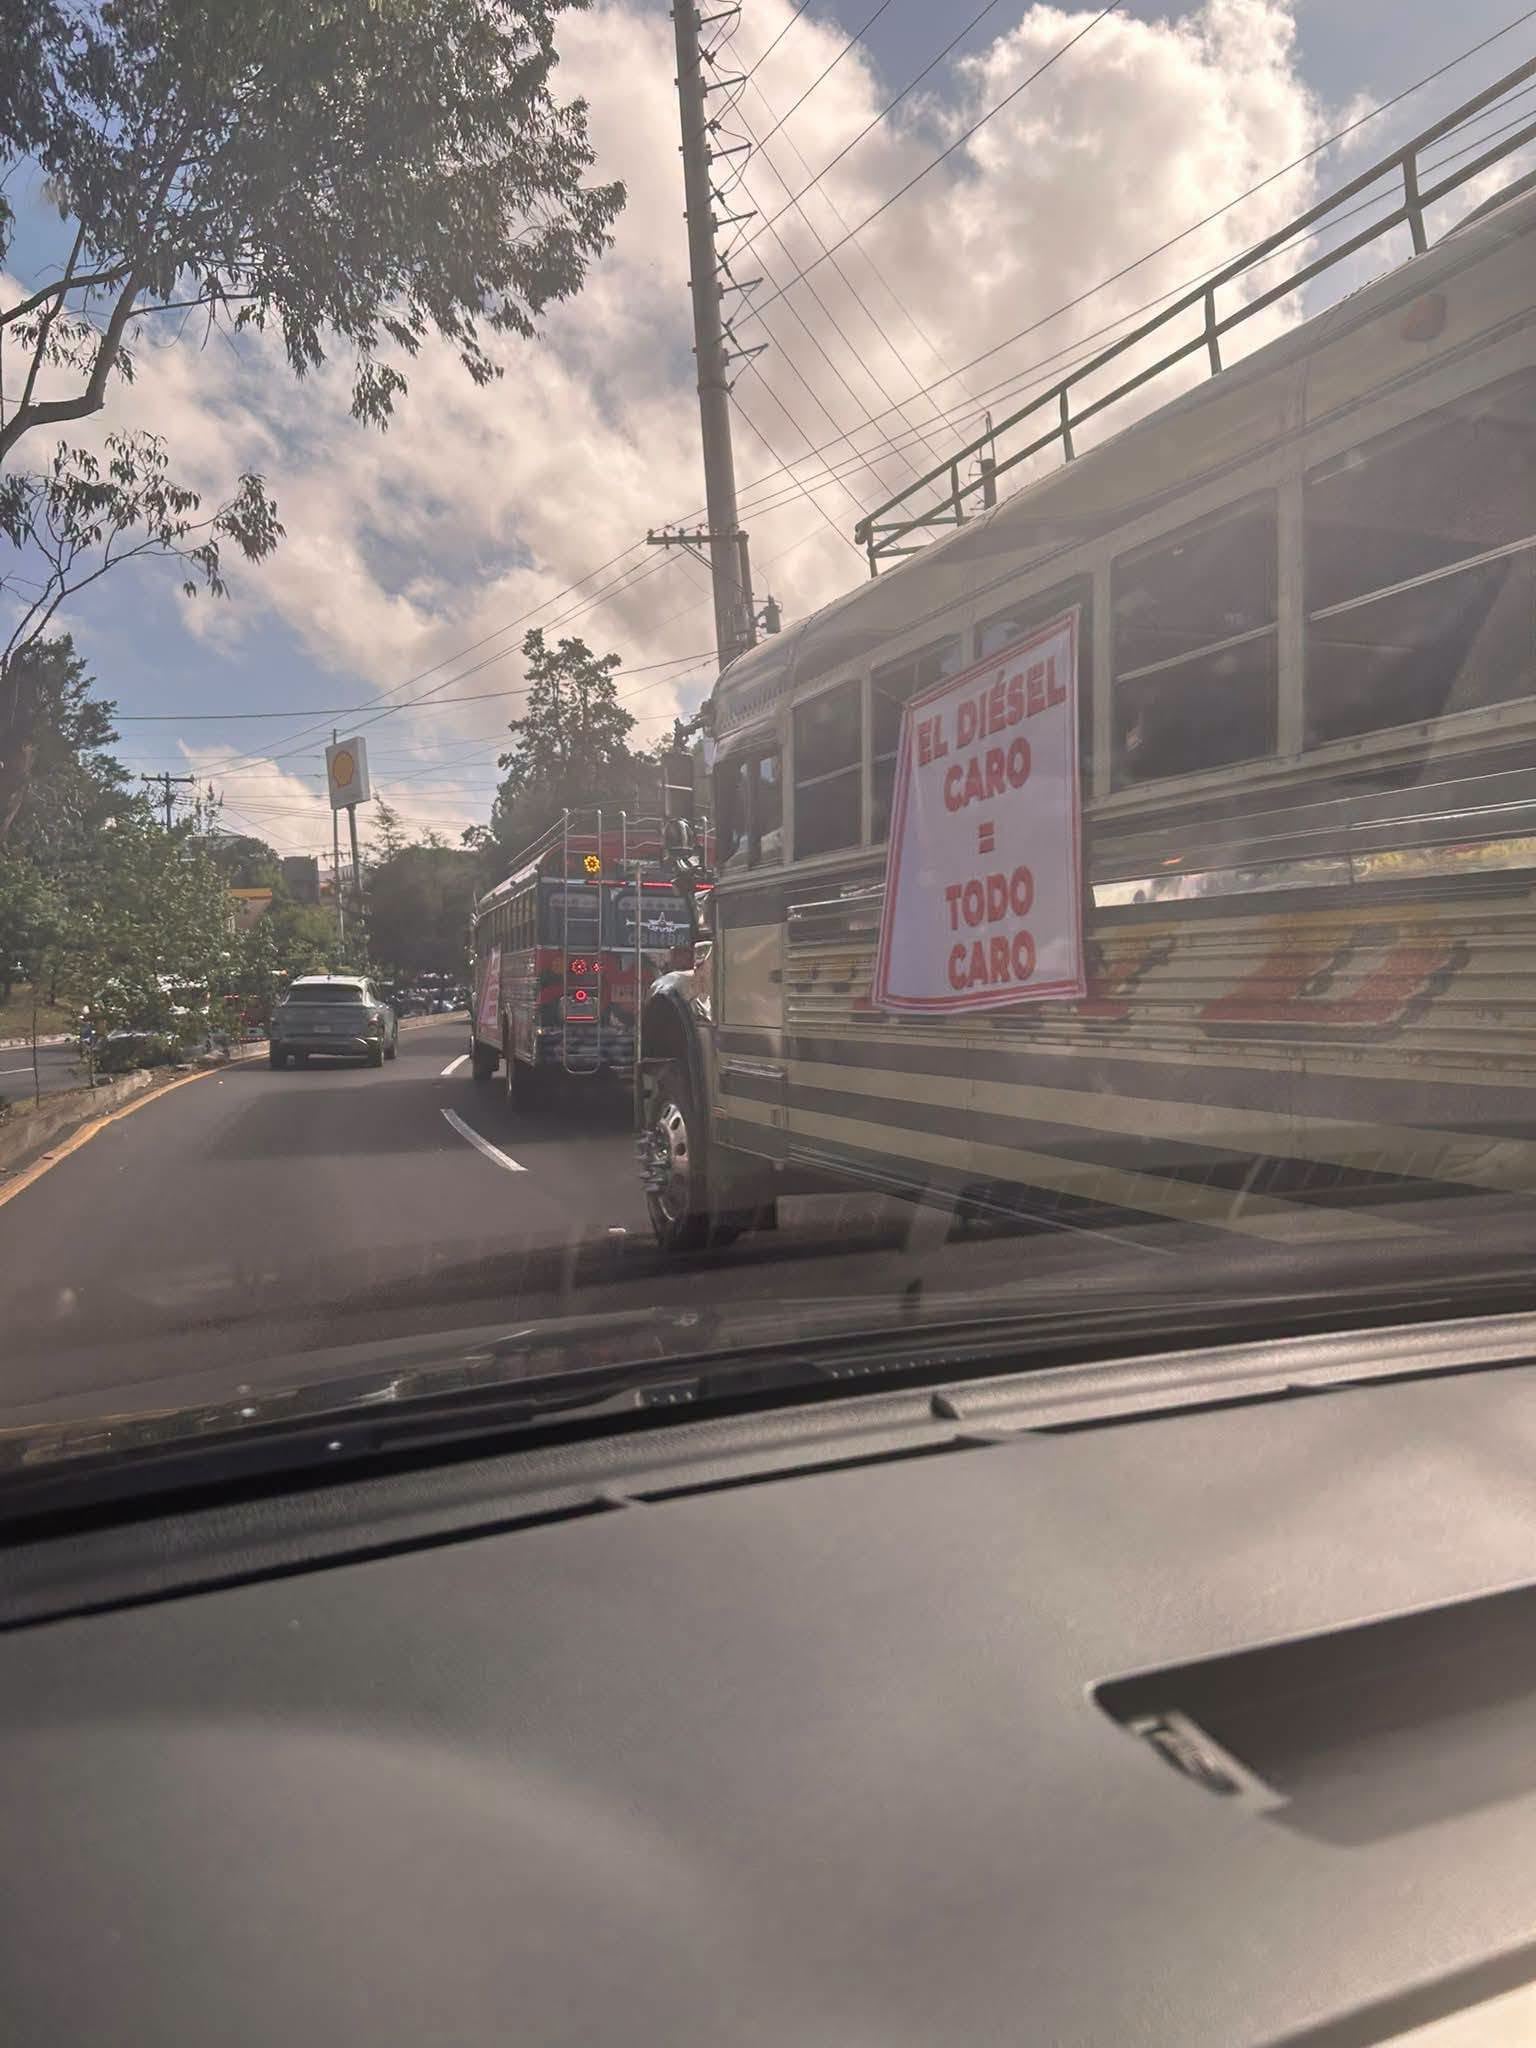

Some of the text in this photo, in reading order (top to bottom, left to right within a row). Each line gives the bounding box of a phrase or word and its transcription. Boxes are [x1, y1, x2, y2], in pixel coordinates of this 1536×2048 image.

[917, 655, 1067, 767] EL DIÉSEL
[943, 736, 1032, 812] CARO
[945, 865, 1034, 930] TODO
[948, 929, 1036, 990] CARO
